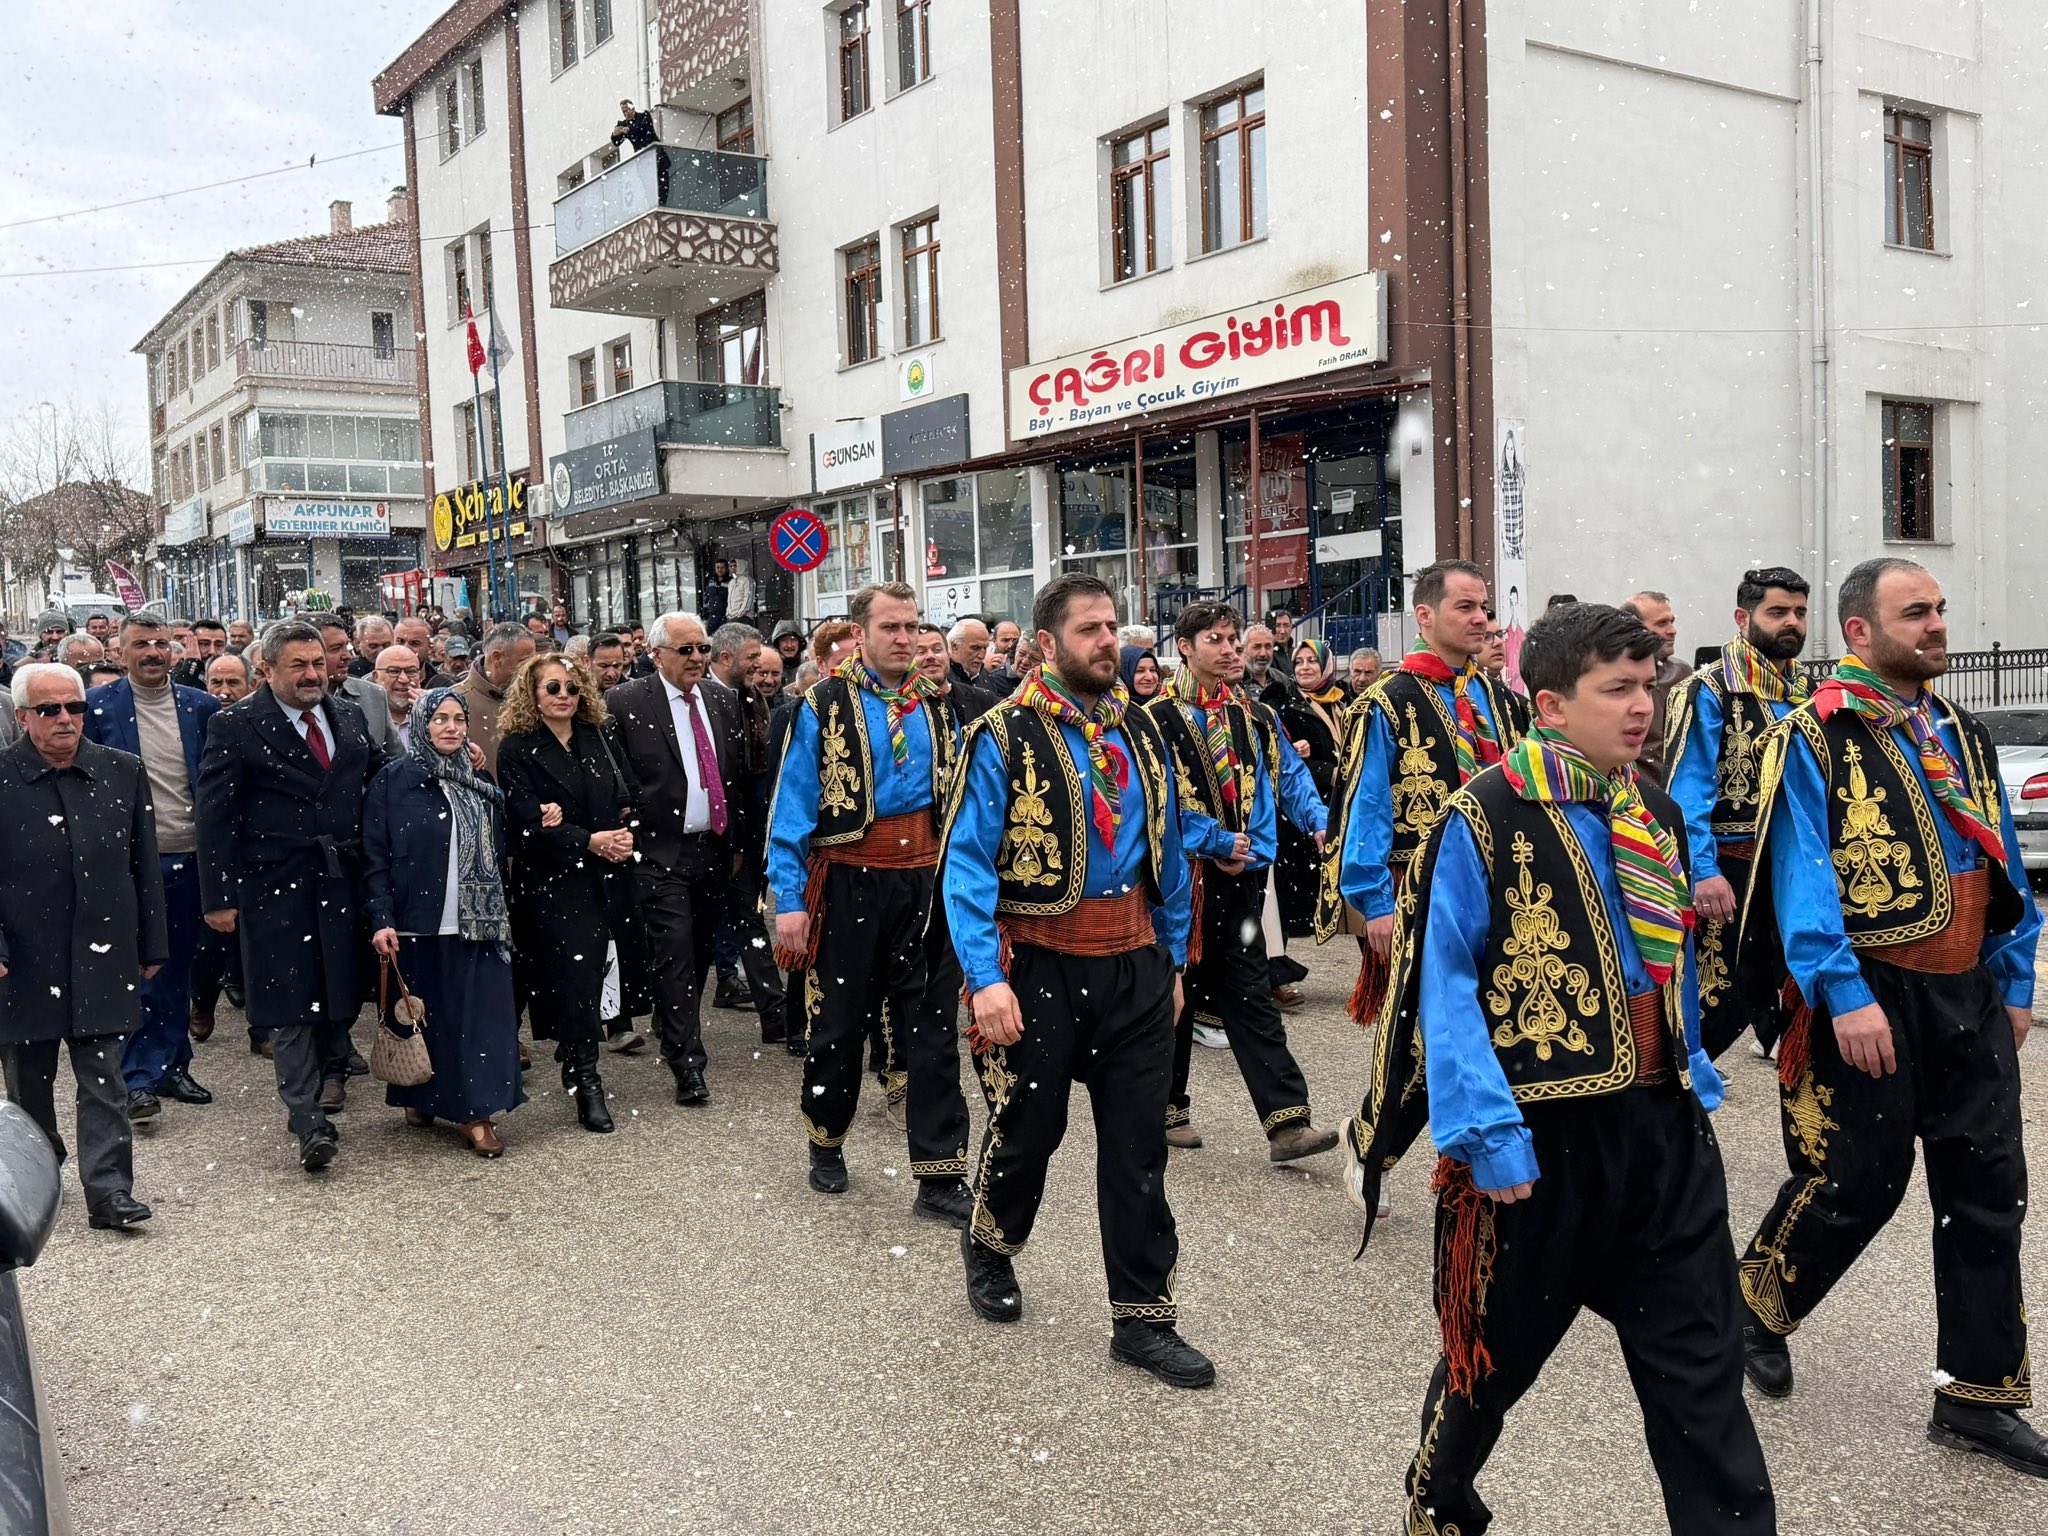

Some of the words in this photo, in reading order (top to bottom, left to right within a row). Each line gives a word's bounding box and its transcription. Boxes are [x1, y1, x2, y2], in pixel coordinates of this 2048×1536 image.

[1318, 355, 1337, 367] Fatih
[1339, 347, 1368, 362] ORHAN
[1028, 344, 1165, 416] ÇAĞRI
[1028, 416, 1055, 433] Bay
[1069, 403, 1111, 423] Bayan
[1116, 400, 1132, 412] ve
[1137, 384, 1186, 411] Çocuk
[1191, 375, 1240, 397] Giyim
[573, 481, 605, 506] BELEDİYE
[609, 469, 655, 499] BAŞKANLIĞI
[594, 458, 628, 480] ORTA
[293, 503, 374, 518] AKPUNAR
[455, 473, 524, 535] Şehae
